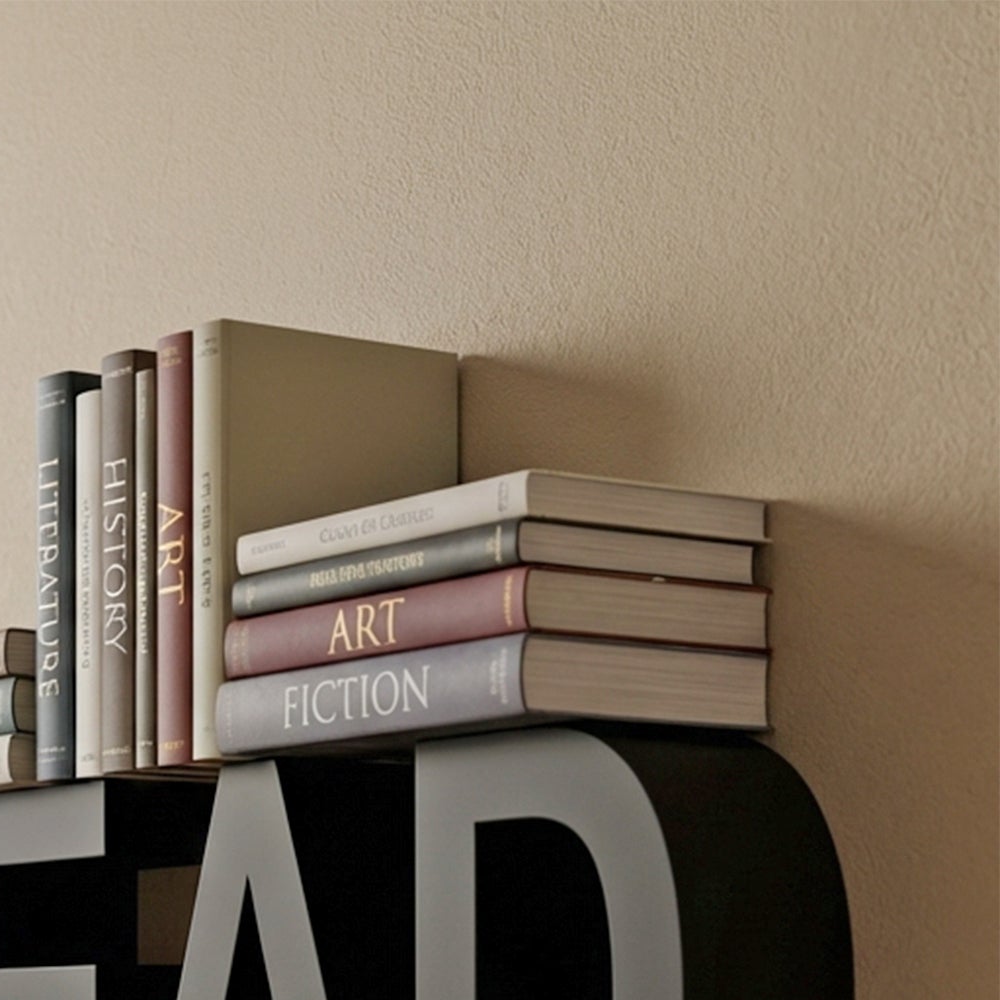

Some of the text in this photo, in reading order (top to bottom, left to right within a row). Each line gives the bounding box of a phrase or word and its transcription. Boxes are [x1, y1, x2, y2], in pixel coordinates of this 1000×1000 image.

[103, 458, 128, 655] HISTORY
[157, 503, 185, 606] ART
[327, 596, 406, 656] ART
[283, 664, 431, 729] FICTION
